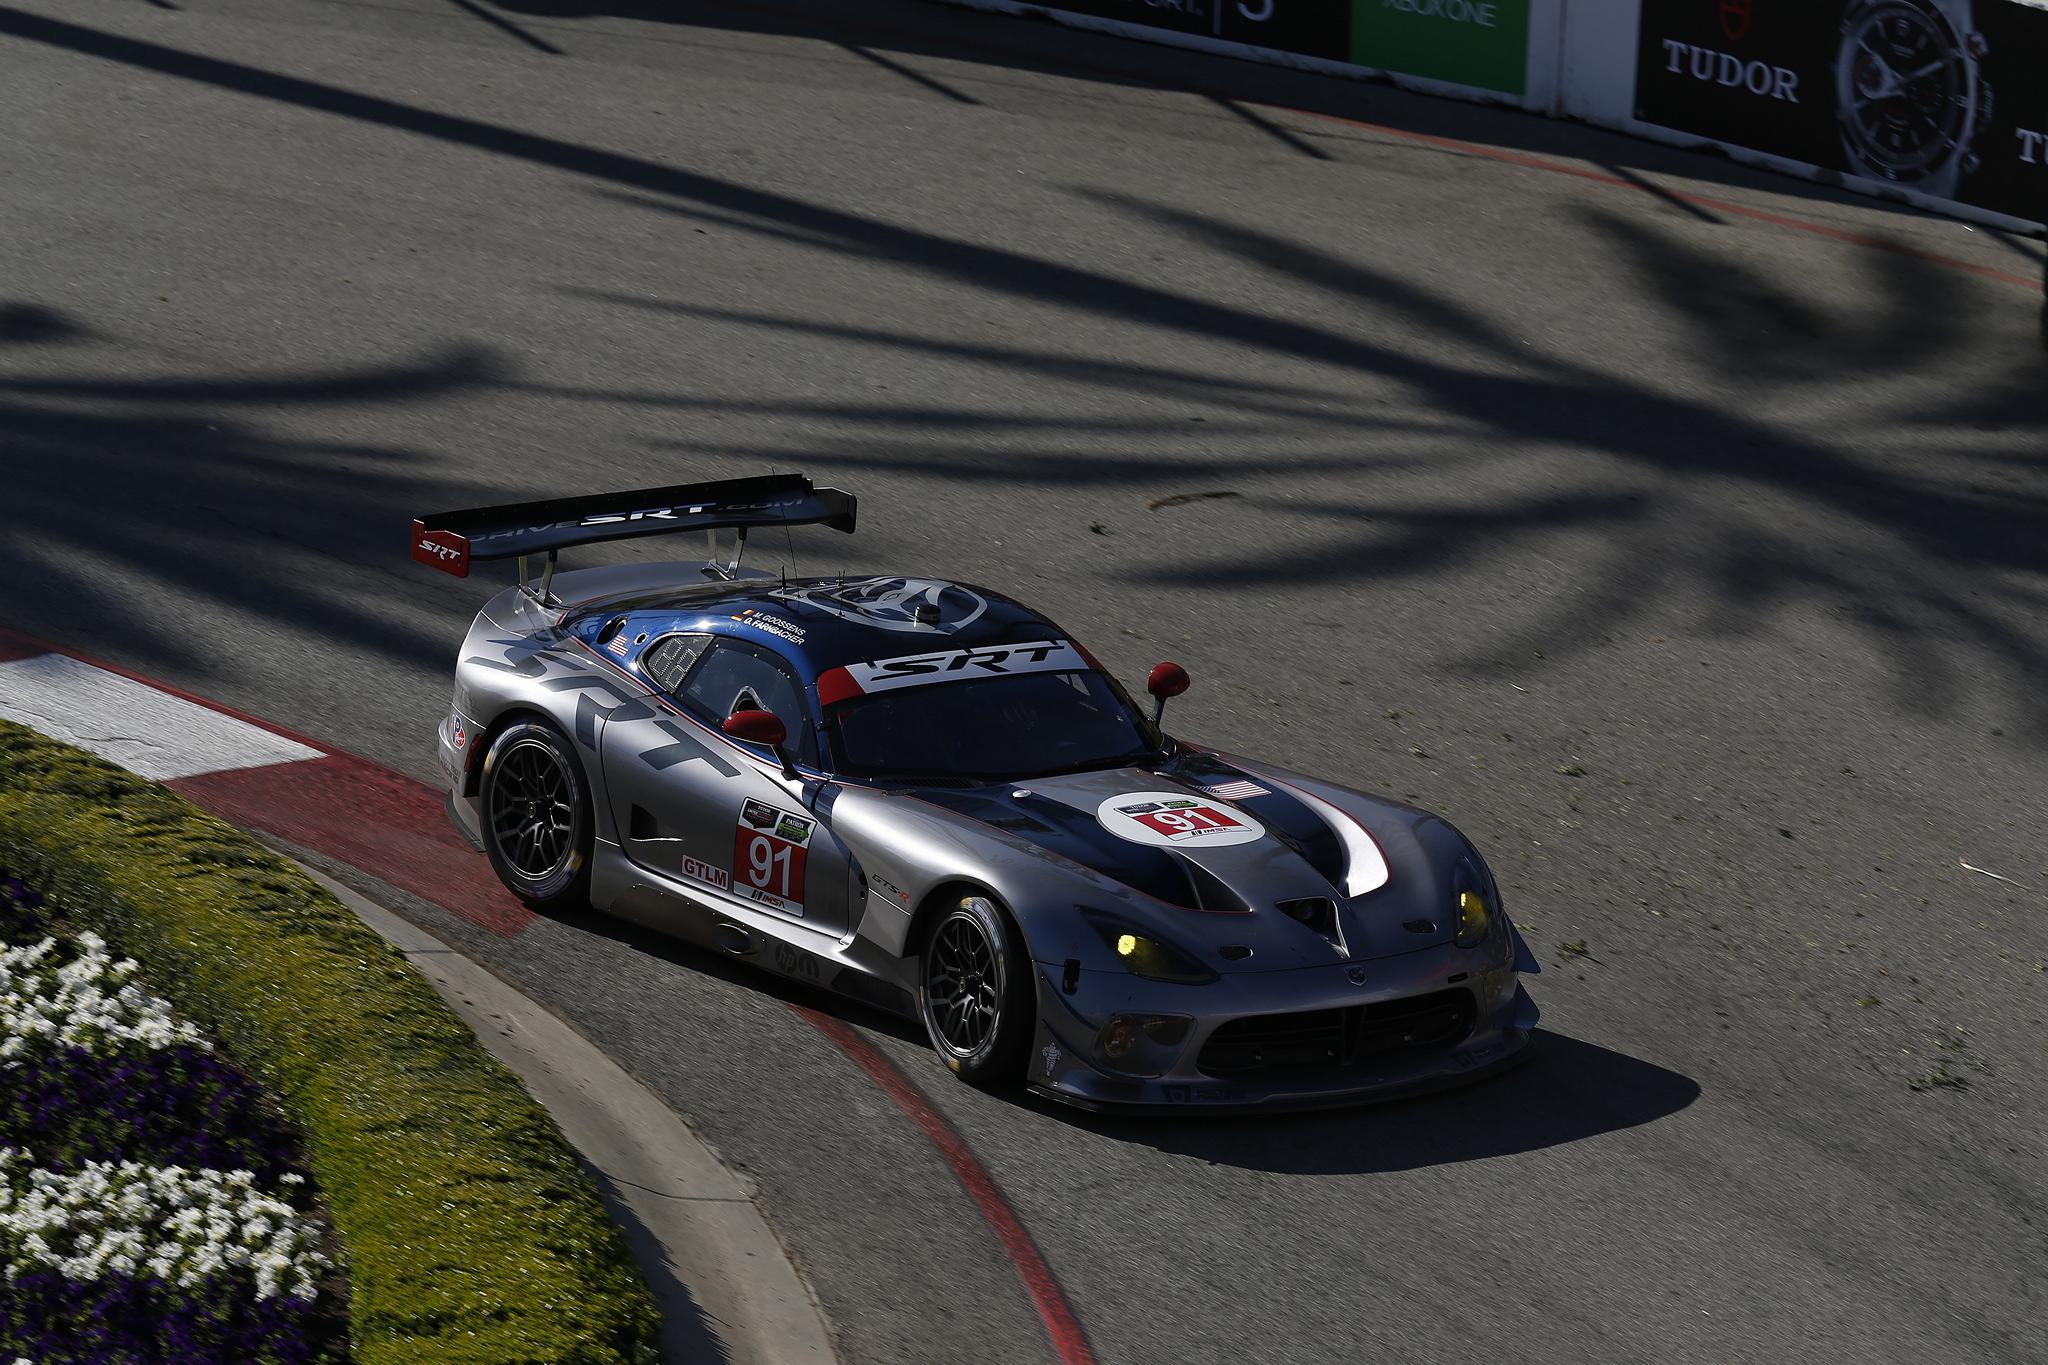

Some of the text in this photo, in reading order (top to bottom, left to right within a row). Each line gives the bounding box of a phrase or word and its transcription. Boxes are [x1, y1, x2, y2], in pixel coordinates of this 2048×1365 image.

[1662, 38, 1800, 104] TUDOR
[418, 539, 461, 560] SRT
[752, 618, 805, 645] FARNBACHER
[762, 614, 806, 636] GOOSSENS
[870, 645, 1065, 681] SRT
[1153, 809, 1221, 831] 91
[684, 858, 727, 888] GTLM
[749, 836, 792, 897] 91
[762, 894, 786, 909] IMSA
[871, 873, 909, 904] GTS-R
